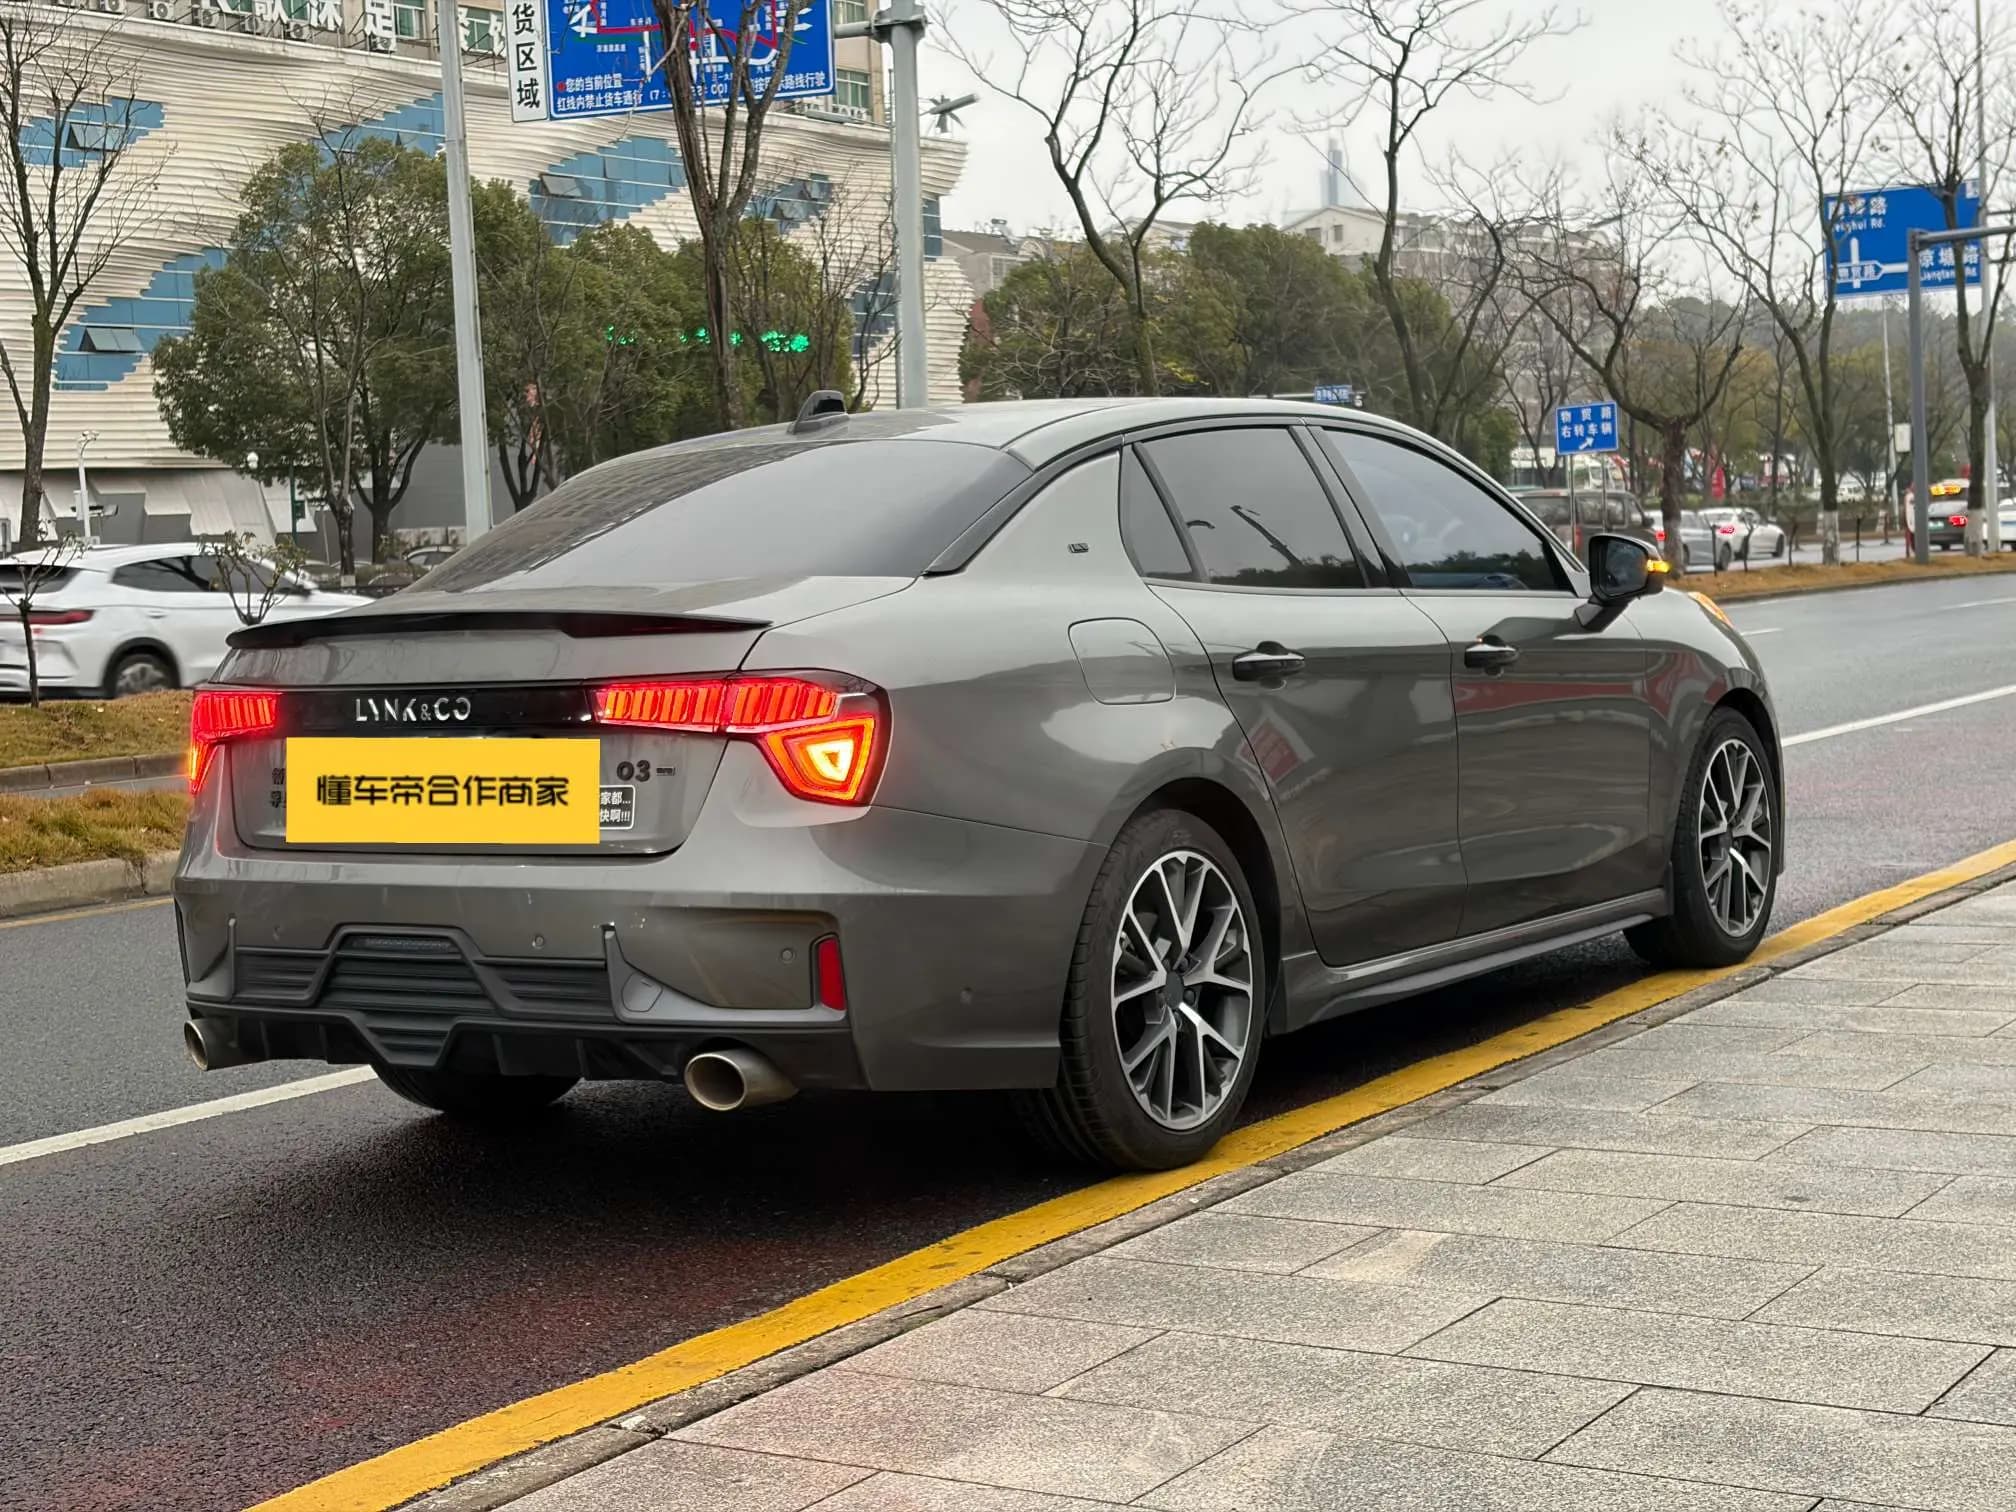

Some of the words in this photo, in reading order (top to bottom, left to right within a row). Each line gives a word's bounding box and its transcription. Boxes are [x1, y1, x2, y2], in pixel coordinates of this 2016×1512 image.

[512, 3, 541, 108] 货区域
[566, 73, 623, 93] 您的当前位置
[557, 88, 643, 112] 红线内禁止货车通行
[355, 697, 471, 722] LYNK&CO
[616, 759, 651, 783] 03
